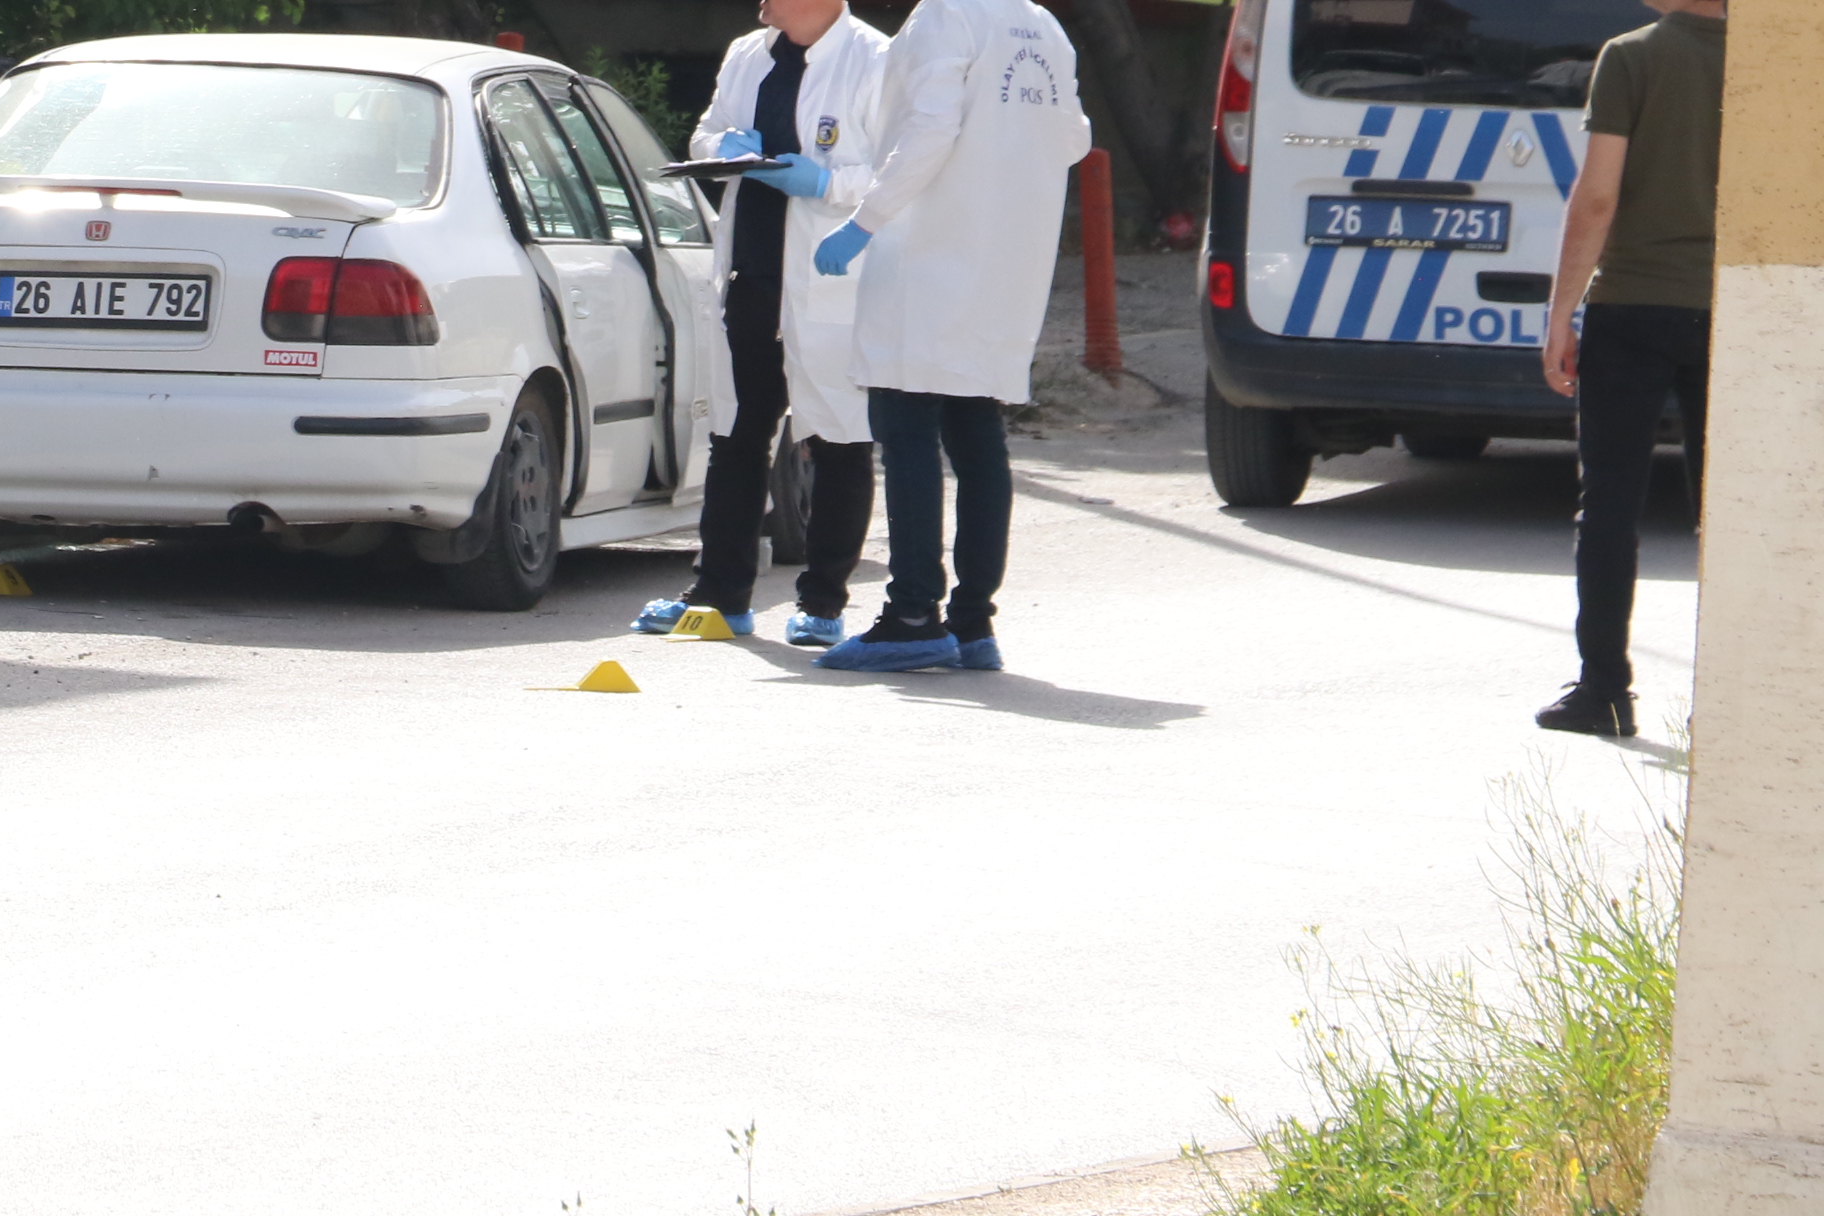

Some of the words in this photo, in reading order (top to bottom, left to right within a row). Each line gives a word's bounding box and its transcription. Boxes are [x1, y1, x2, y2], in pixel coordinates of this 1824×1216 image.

[1327, 204, 1362, 235] 26
[1387, 205, 1404, 236] A
[1431, 207, 1501, 240] 7251
[1372, 238, 1436, 249] SARAR
[14, 280, 52, 315] 26
[70, 281, 127, 316] AIE
[146, 282, 203, 318] 792
[266, 352, 316, 365] MOTUL
[681, 615, 703, 631] 10
